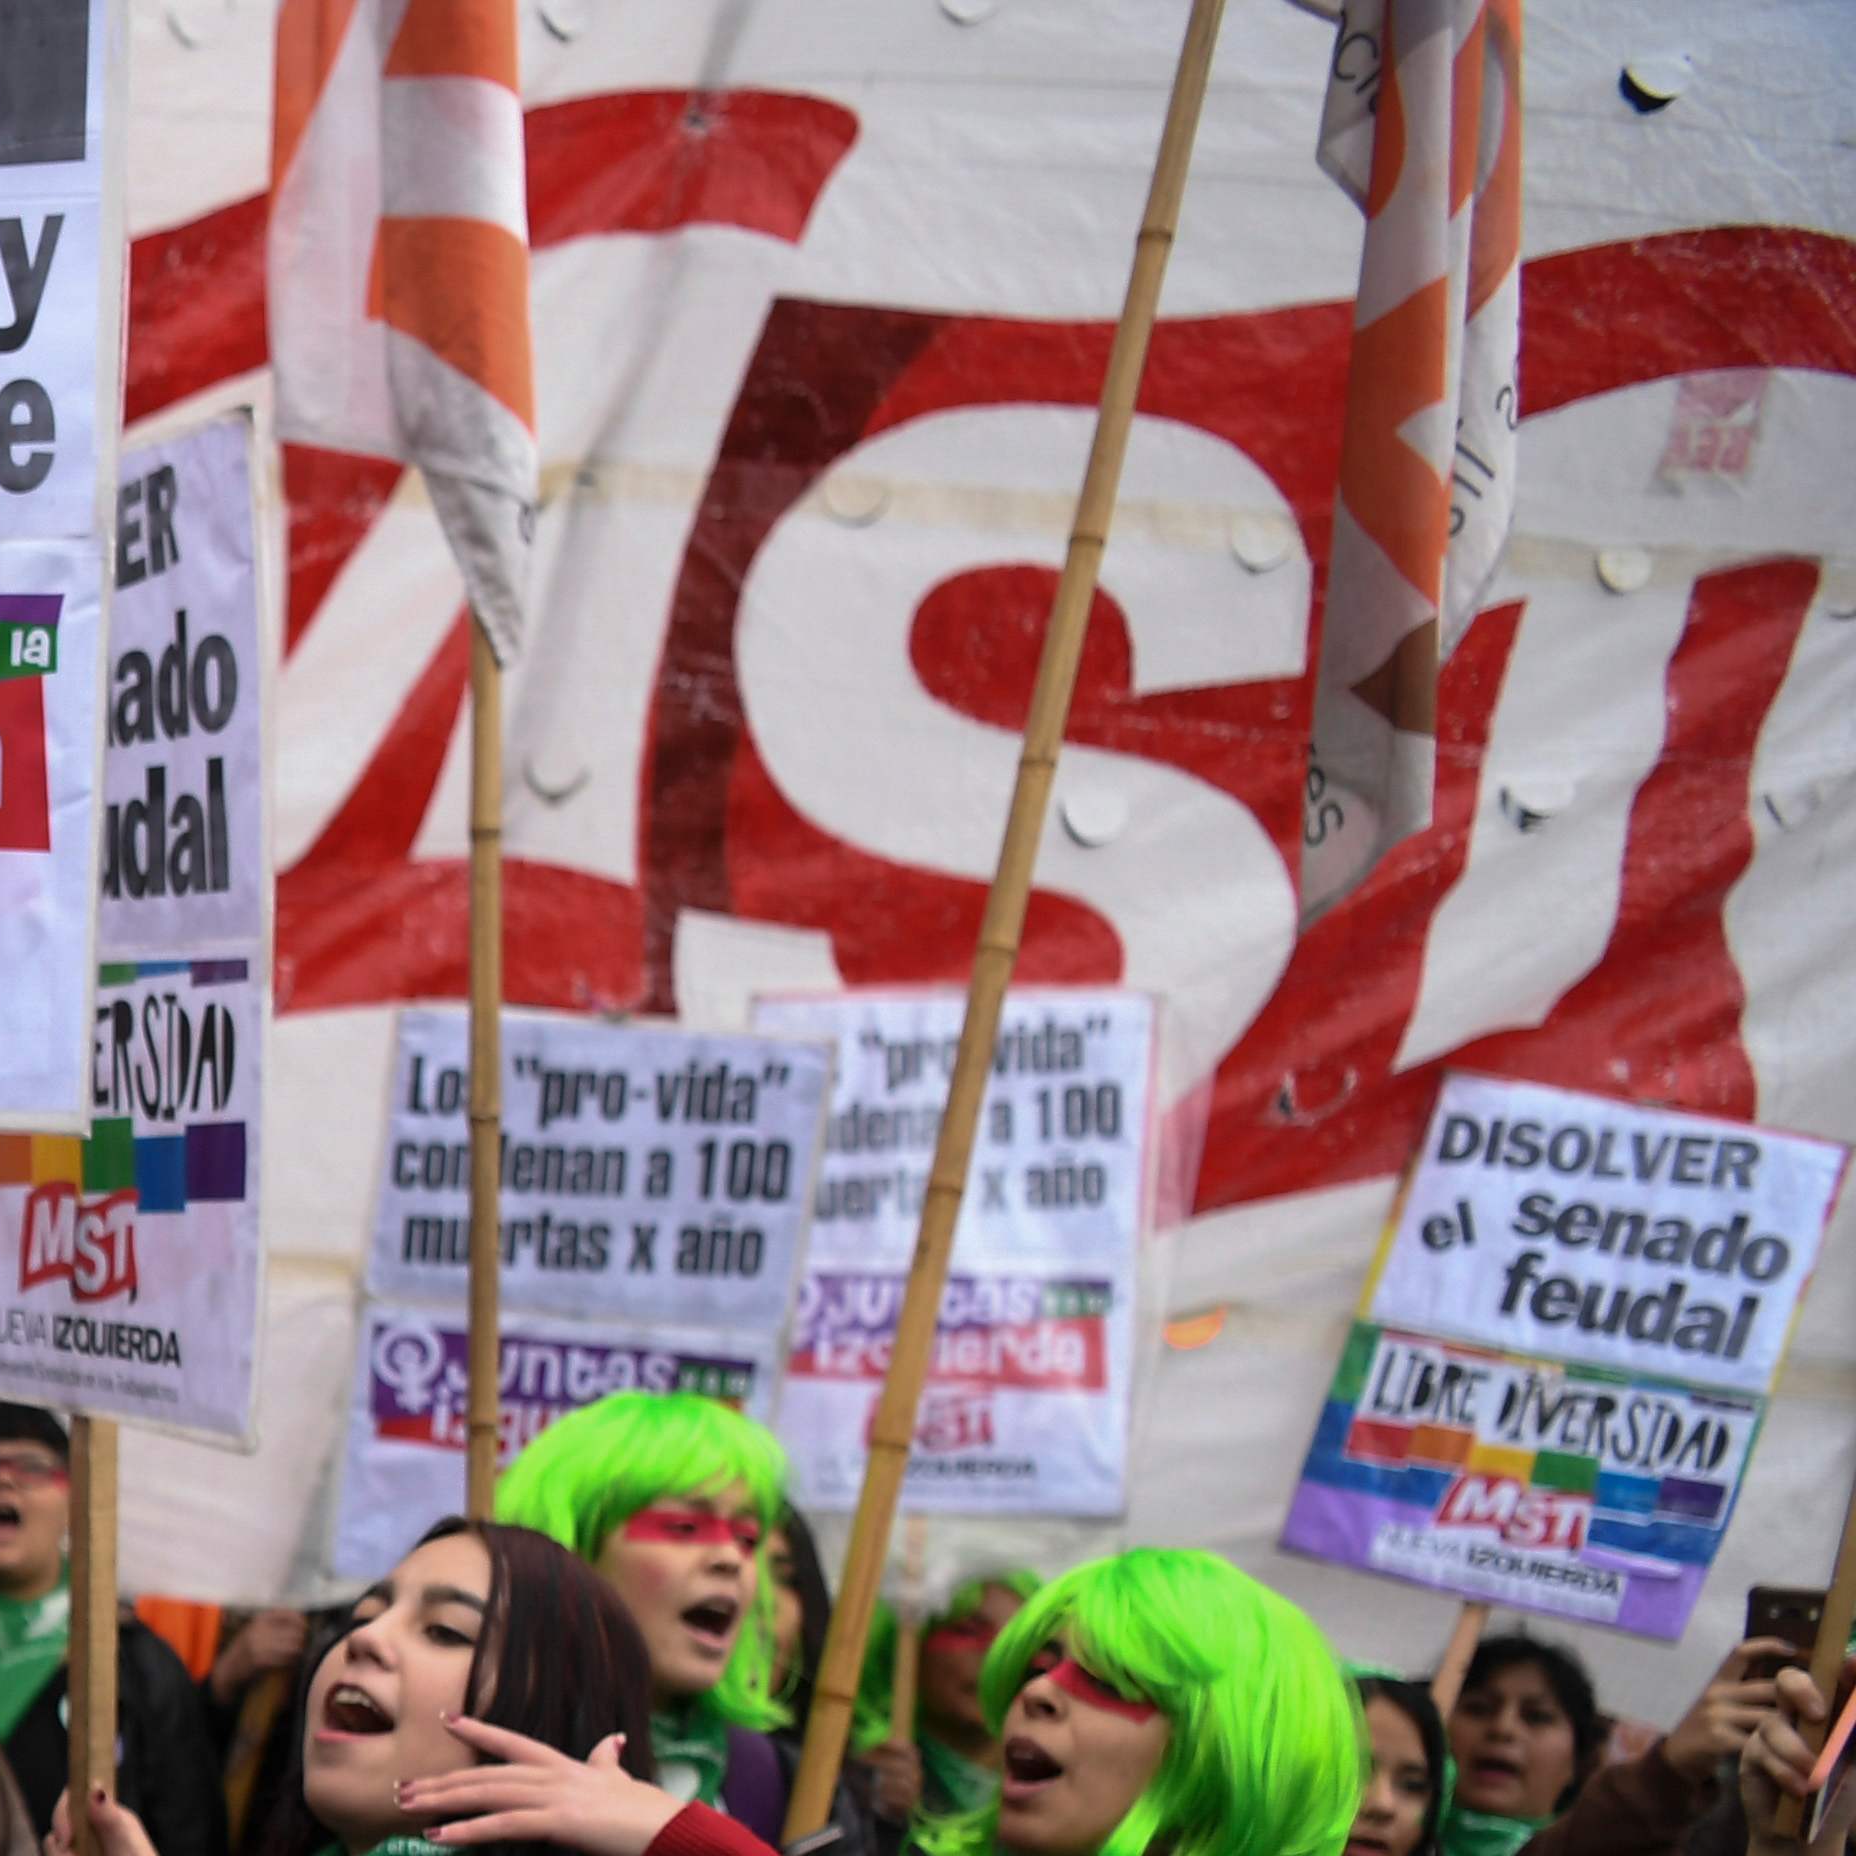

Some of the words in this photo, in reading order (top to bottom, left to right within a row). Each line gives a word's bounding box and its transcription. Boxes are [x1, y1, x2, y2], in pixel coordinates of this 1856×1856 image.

[107, 608, 239, 748] ado
[92, 993, 236, 1122] ERSIDAD
[406, 1054, 468, 1118] Lo
[513, 1054, 792, 1130] "pro-vida"
[858, 1011, 1111, 1094] "provida"
[1036, 1082, 1123, 1143] 100
[392, 1130, 628, 1195] conenan
[644, 1148, 675, 1198] a
[698, 1137, 793, 1202] 100
[1436, 1113, 1763, 1192] DISOLVER
[25, 1193, 139, 1294] MST
[402, 1210, 609, 1272] murtas
[629, 1224, 657, 1272] x
[675, 1210, 766, 1279] año
[1420, 1198, 1477, 1254] el
[1510, 1190, 1791, 1285] senado
[50, 1313, 182, 1369] IZQUIERDA
[1498, 1250, 1762, 1361] feudal
[1373, 1347, 1490, 1425] LIBRE
[1496, 1365, 1730, 1471] DIVERSIDAD
[1450, 1476, 1594, 1547] MST
